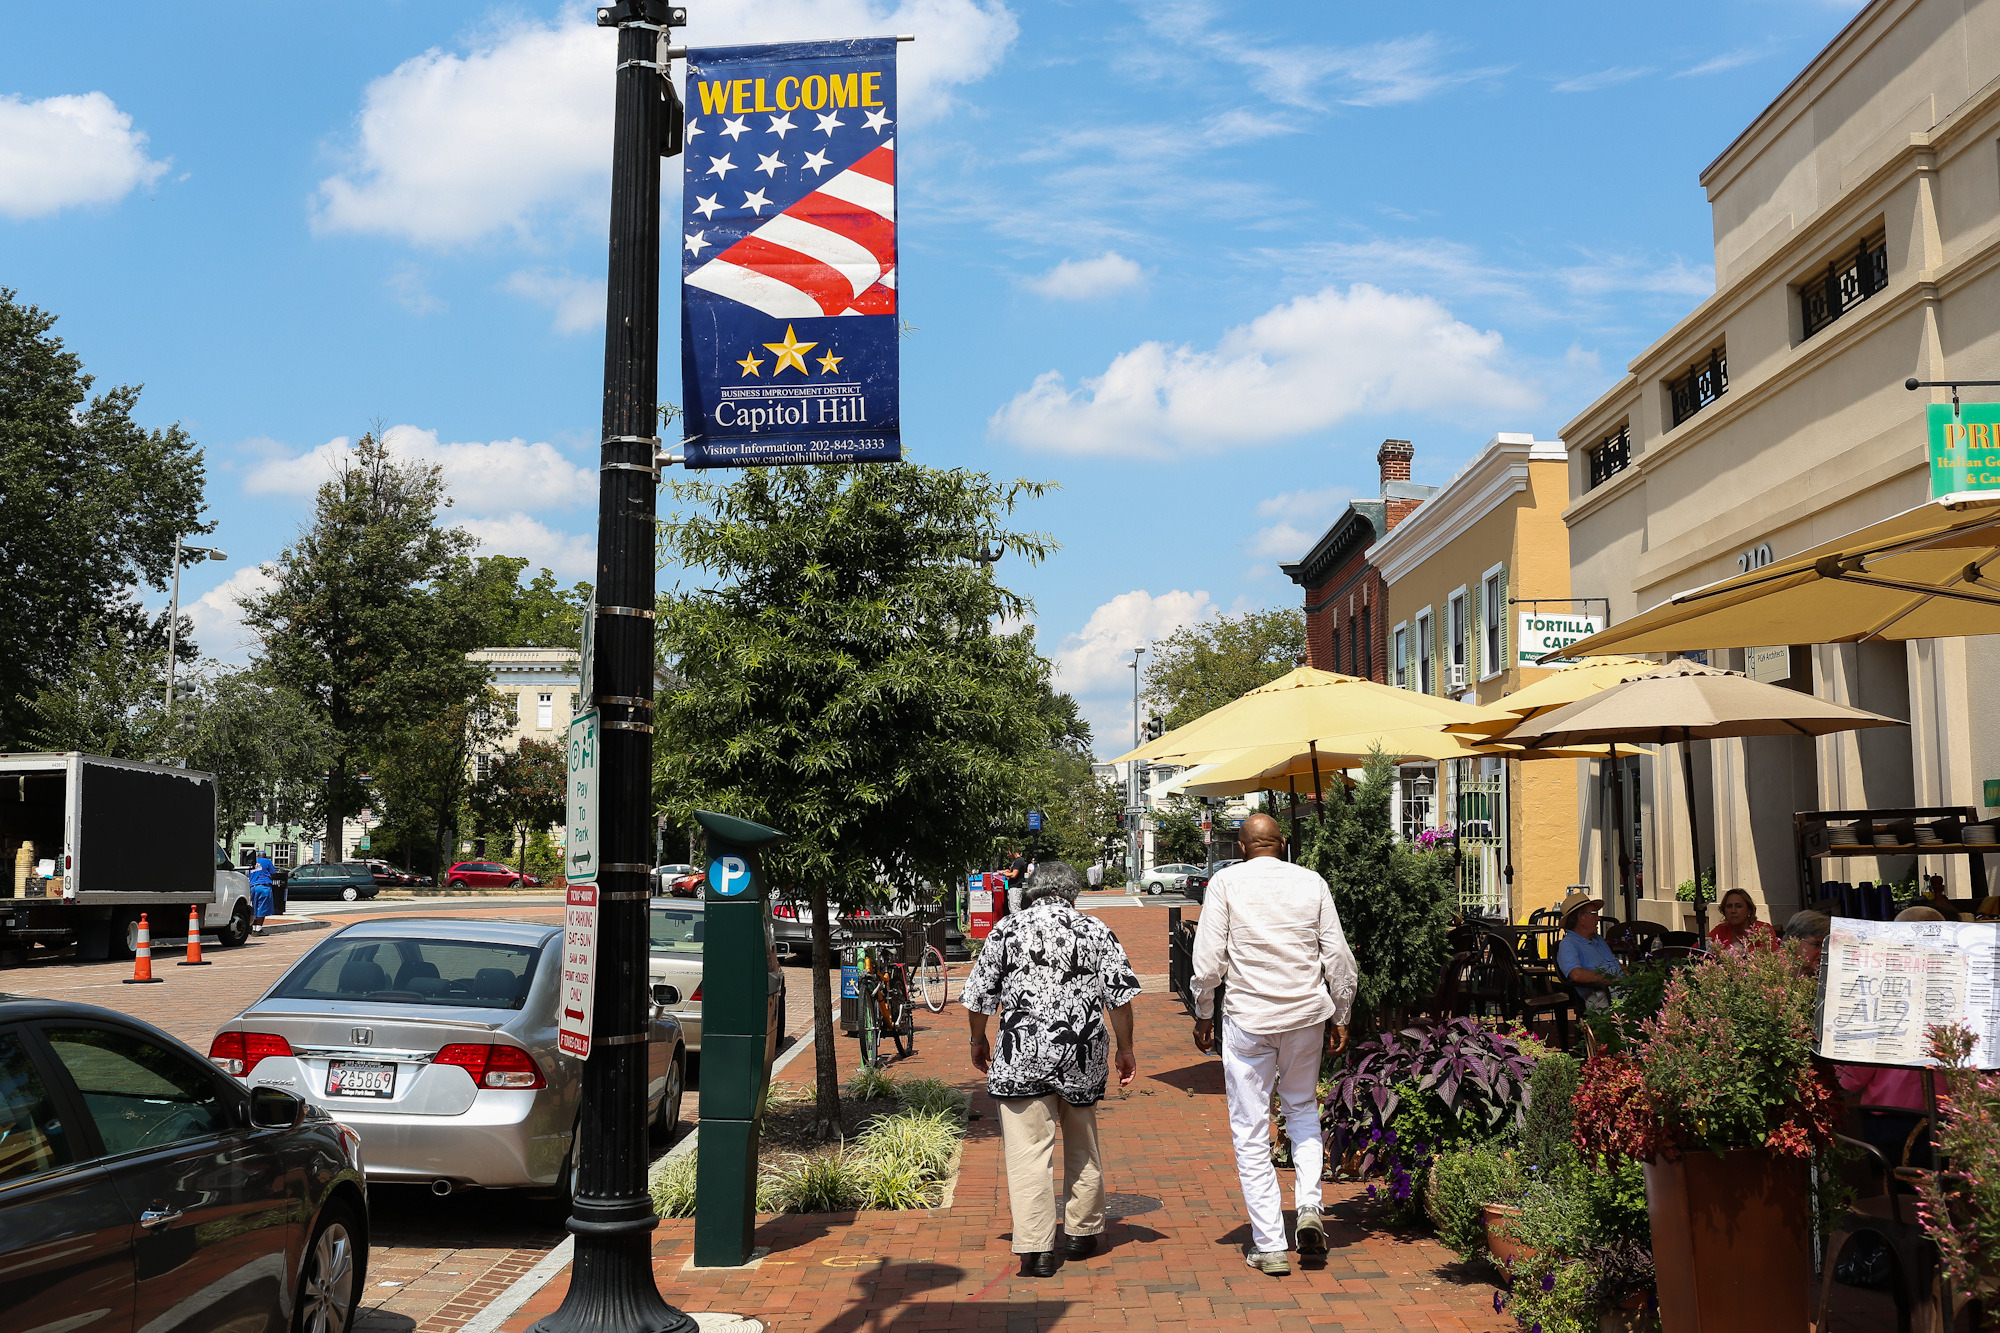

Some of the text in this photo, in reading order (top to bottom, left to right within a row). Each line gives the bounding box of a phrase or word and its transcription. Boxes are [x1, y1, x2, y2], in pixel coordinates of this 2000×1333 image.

[698, 72, 883, 115] WELCOME
[721, 386, 861, 398] BUSINESS IMPROVEMENT DISTRICT
[715, 397, 867, 432] Capitol Hill
[702, 439, 885, 455] Visitor Information: 202-842-3333
[732, 452, 854, 465] www.capitolhillbid.org
[1937, 456, 1982, 468] Italian
[1966, 473, 2000, 484] & Ca
[1526, 619, 1594, 634] TORTILLA
[576, 781, 588, 799] Pay
[1986, 787, 2000, 799] OP
[578, 806, 585, 821] To
[575, 826, 589, 843] Park
[721, 856, 745, 893] P
[568, 910, 593, 928] NO PARKING
[568, 932, 591, 948] SAT-SUN
[569, 987, 583, 1002] ONLY
